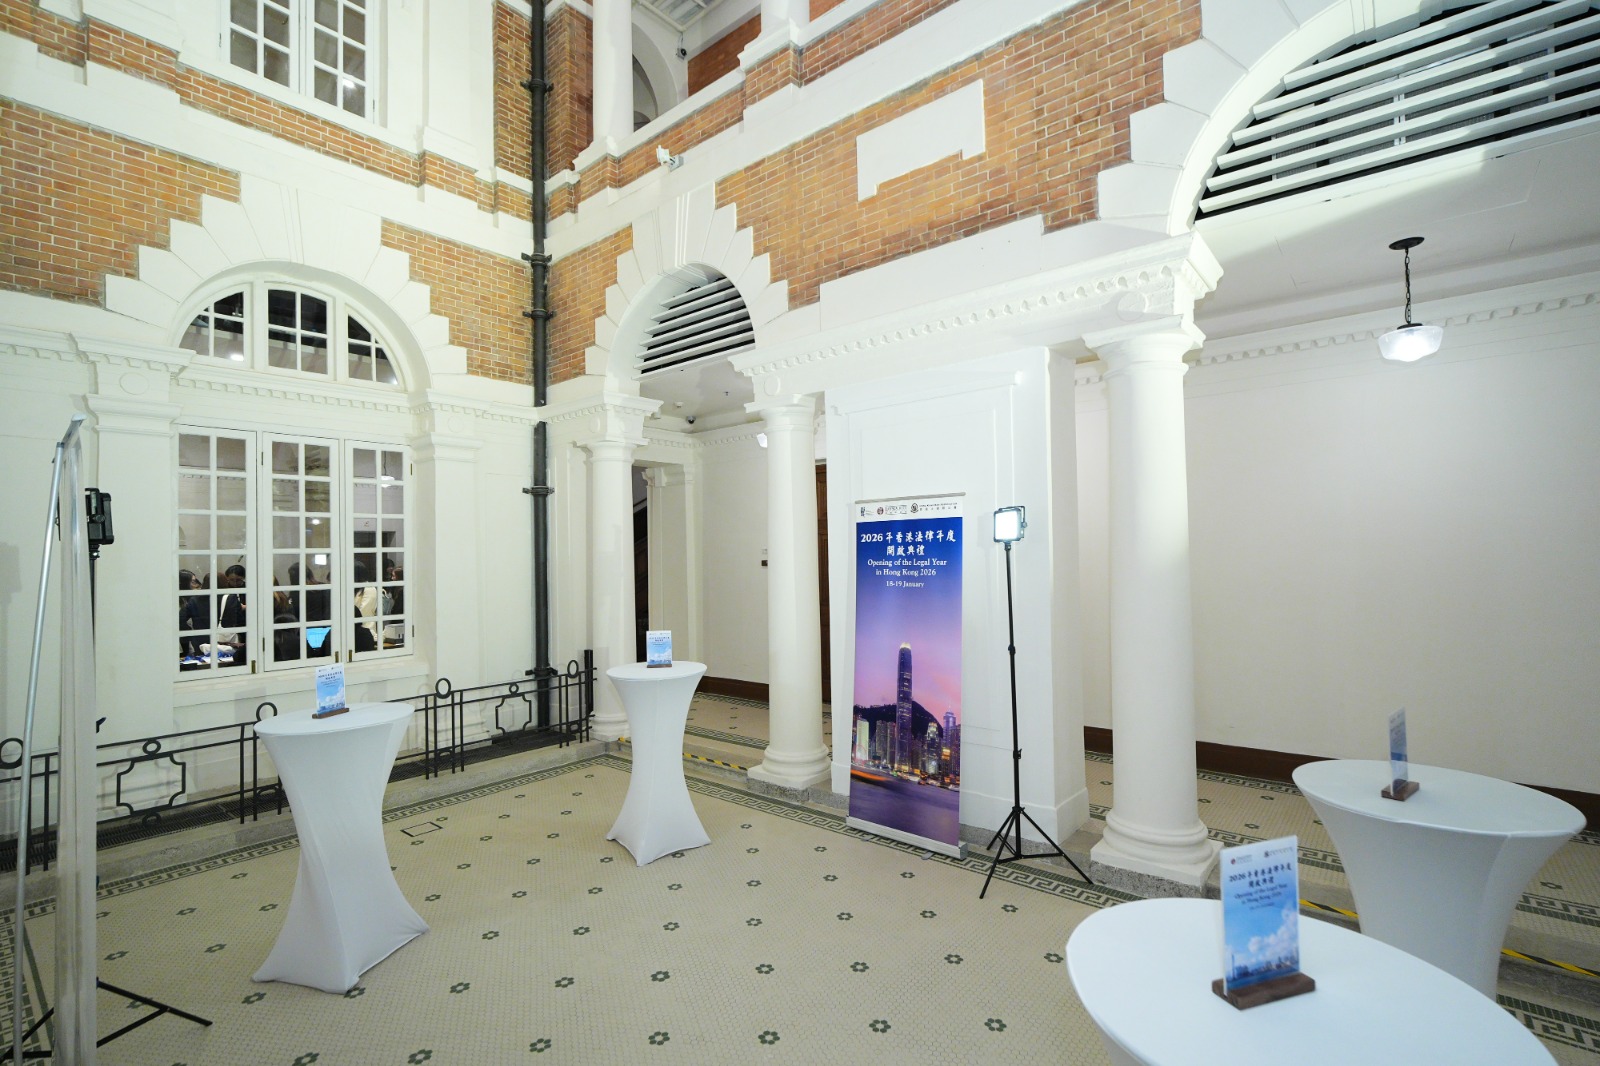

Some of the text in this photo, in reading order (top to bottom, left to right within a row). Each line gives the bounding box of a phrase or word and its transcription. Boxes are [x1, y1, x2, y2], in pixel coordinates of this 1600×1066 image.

[867, 558, 947, 567] Opening of the Legal Year
[875, 568, 937, 577] in Hong Kong 2026
[903, 580, 925, 588] January
